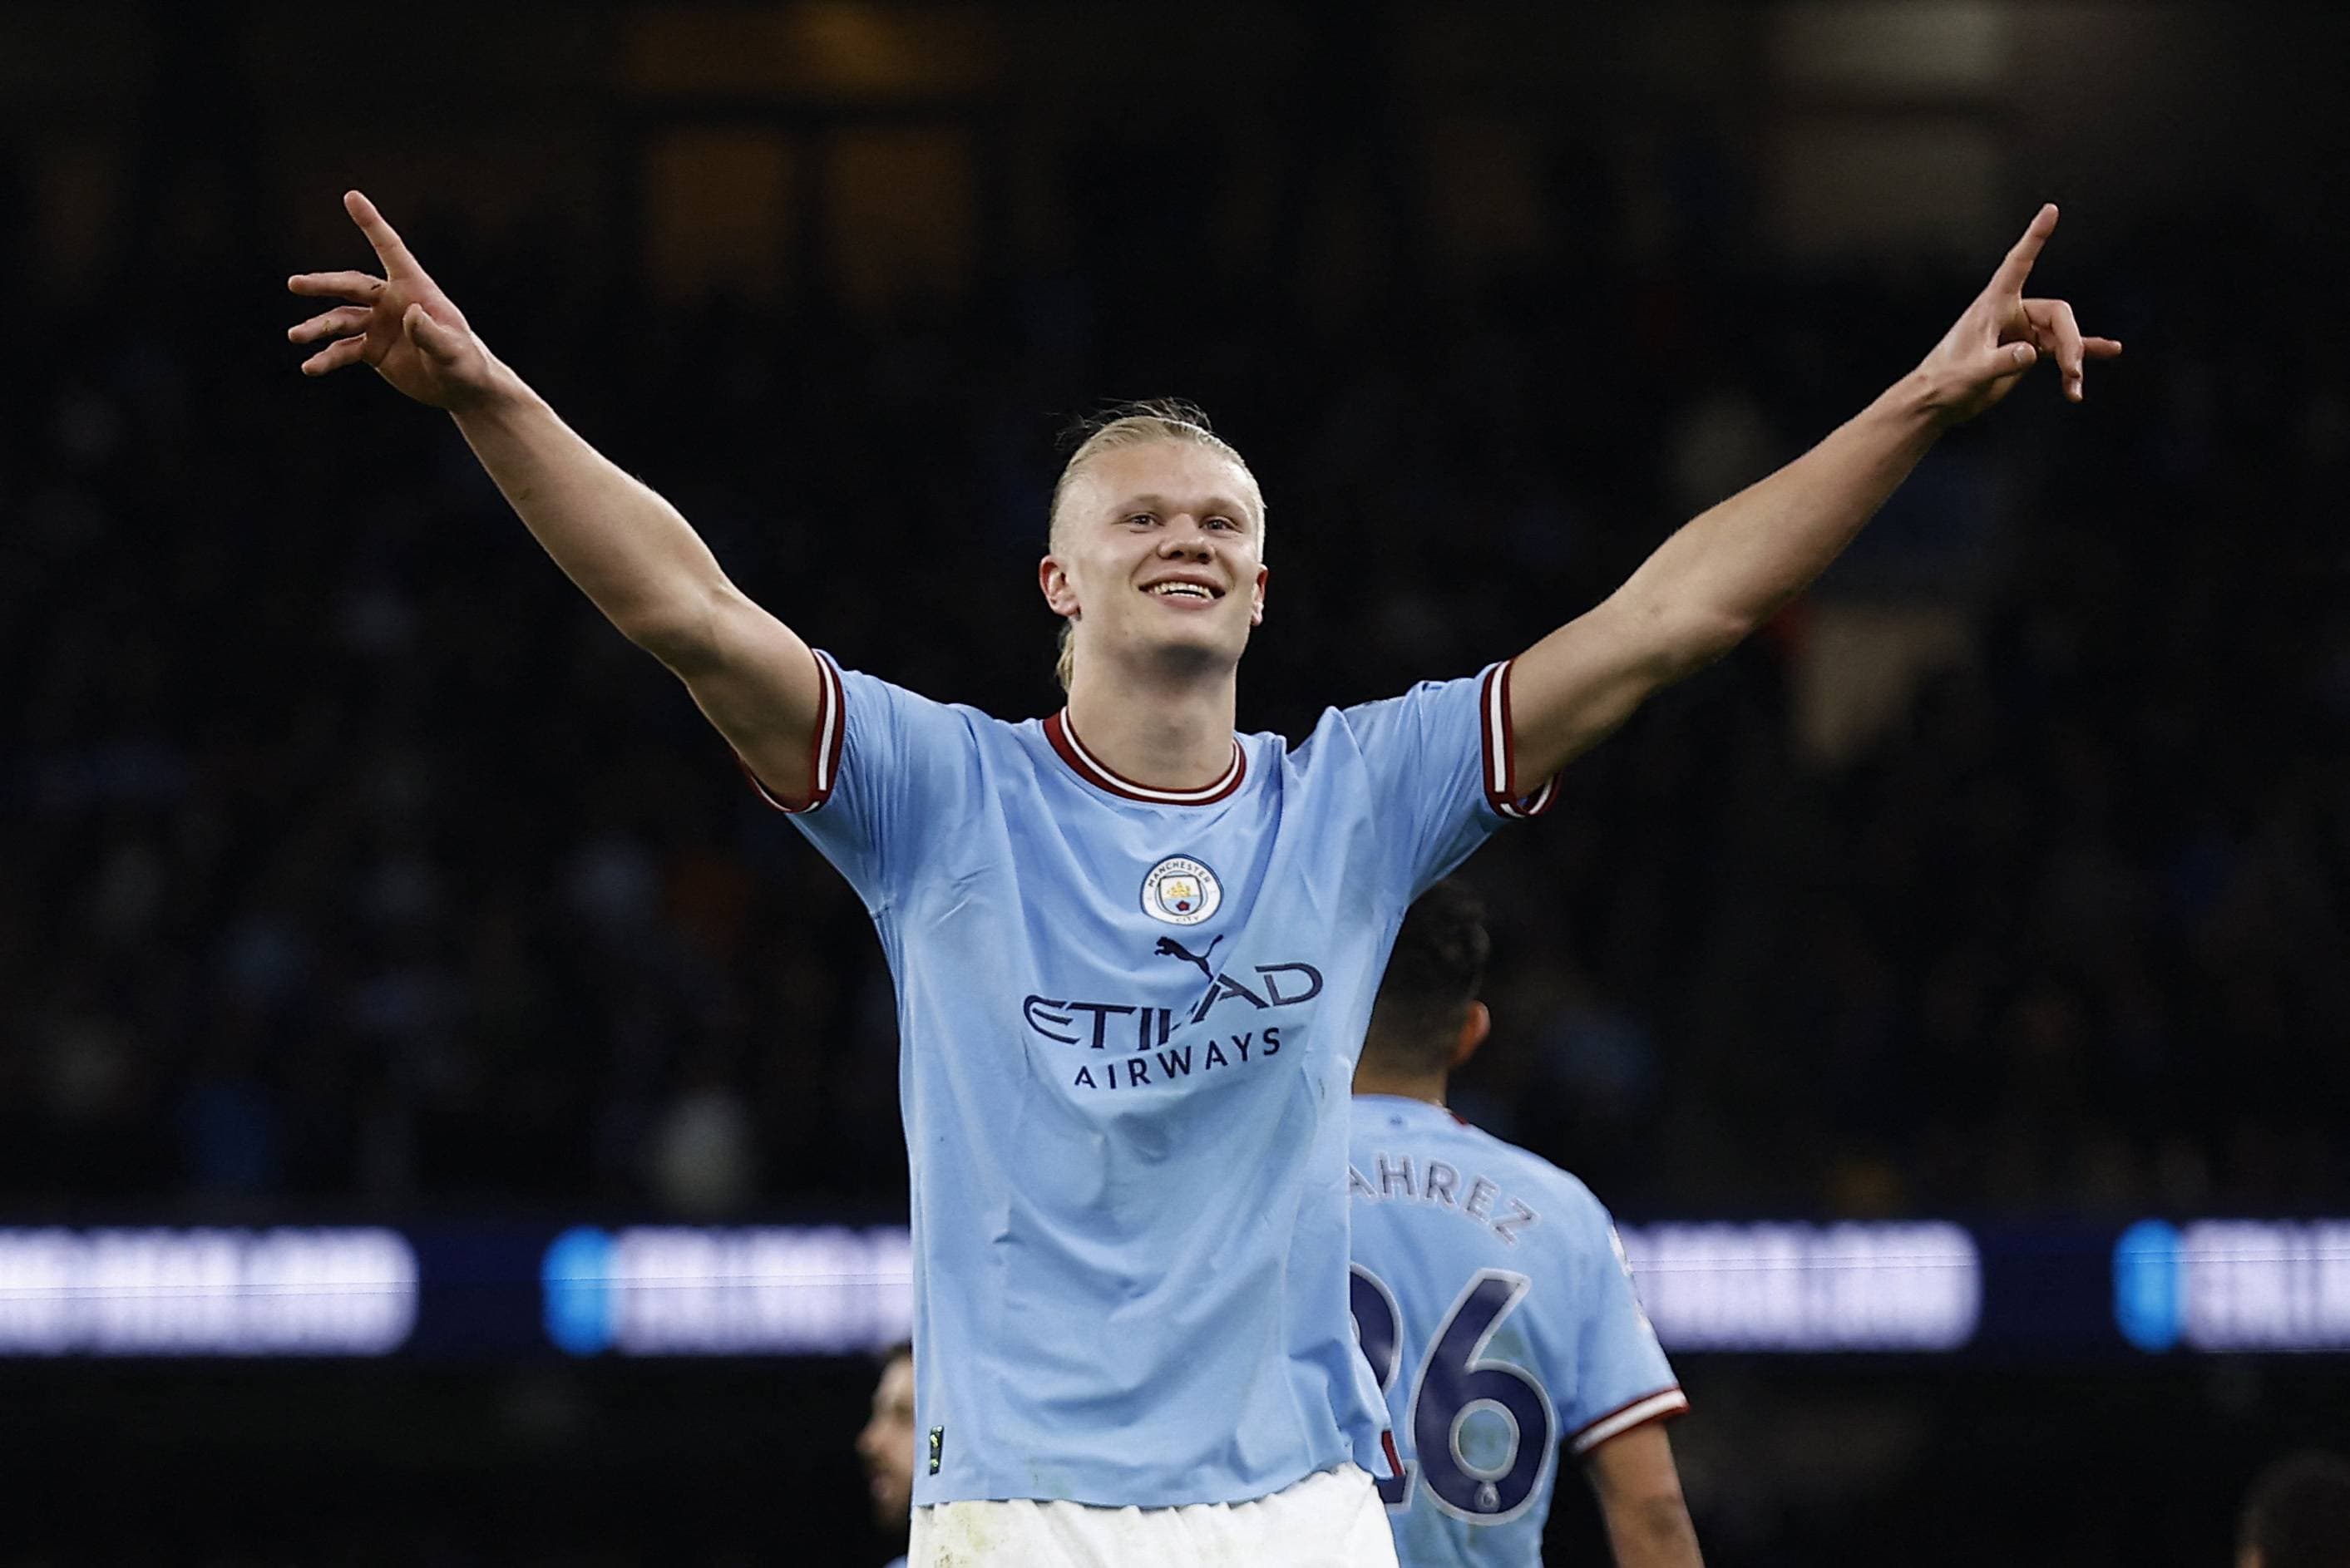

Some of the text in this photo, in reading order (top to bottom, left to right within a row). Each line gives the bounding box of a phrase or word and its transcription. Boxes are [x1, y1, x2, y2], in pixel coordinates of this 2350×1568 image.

[1148, 861, 1211, 887] MANCHESTER
[1074, 1028, 1281, 1089] AIRWAYS
[1349, 1151, 1541, 1245] AHREZ
